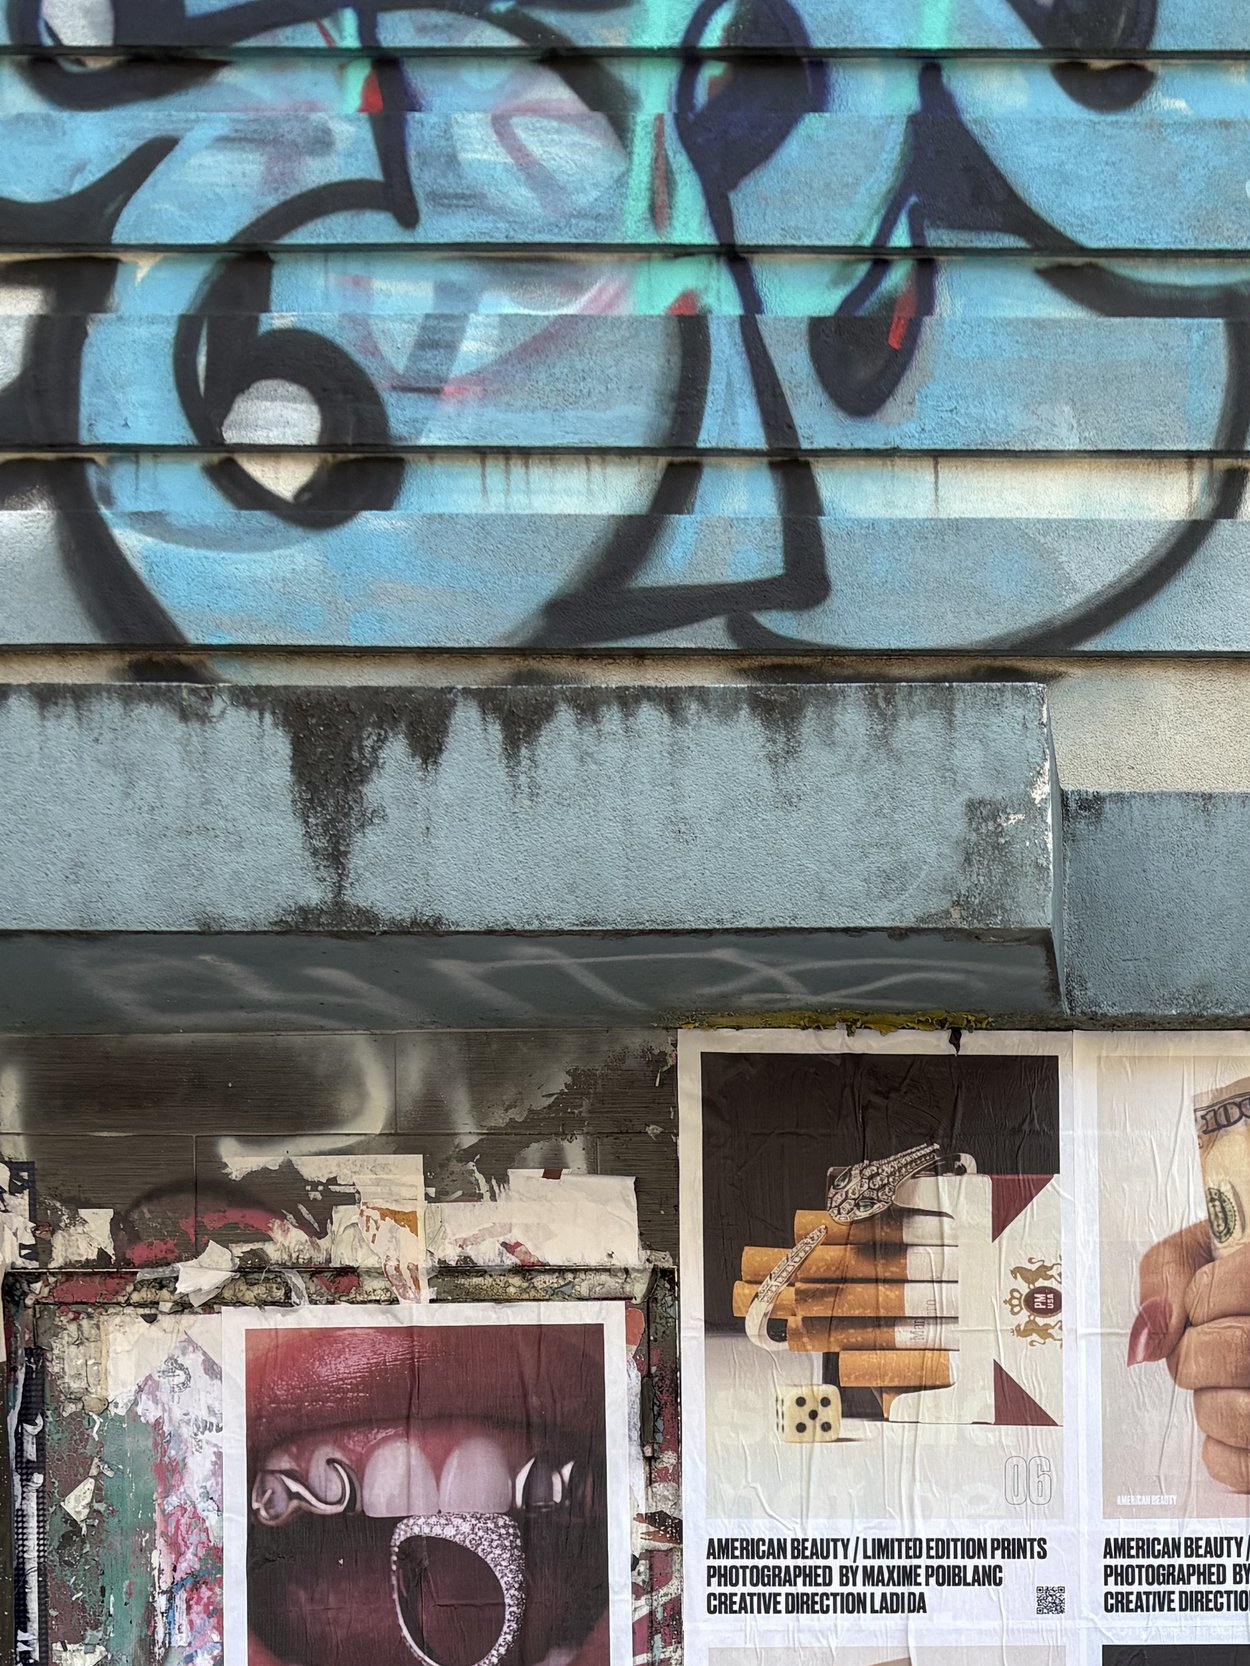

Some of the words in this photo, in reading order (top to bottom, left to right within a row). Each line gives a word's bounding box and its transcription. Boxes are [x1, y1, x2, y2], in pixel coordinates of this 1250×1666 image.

[1034, 1293, 1046, 1309] PM
[1003, 1455, 1052, 1506] 06
[706, 1537, 787, 1559] AMERICAN
[790, 1537, 849, 1559] BEAUTY
[862, 1537, 922, 1559] LIMITED
[925, 1537, 987, 1559] EDITION
[990, 1537, 1046, 1559] PRINTS
[706, 1565, 832, 1586] PHOTOGRAPHED
[839, 1564, 858, 1586] BY
[862, 1564, 921, 1586] MAXIME
[924, 1564, 1002, 1586] POIBLANC
[706, 1592, 781, 1614] CREATIVE
[784, 1592, 866, 1613] DIRECTION
[870, 1592, 904, 1613] LADI
[907, 1591, 926, 1613] DA
